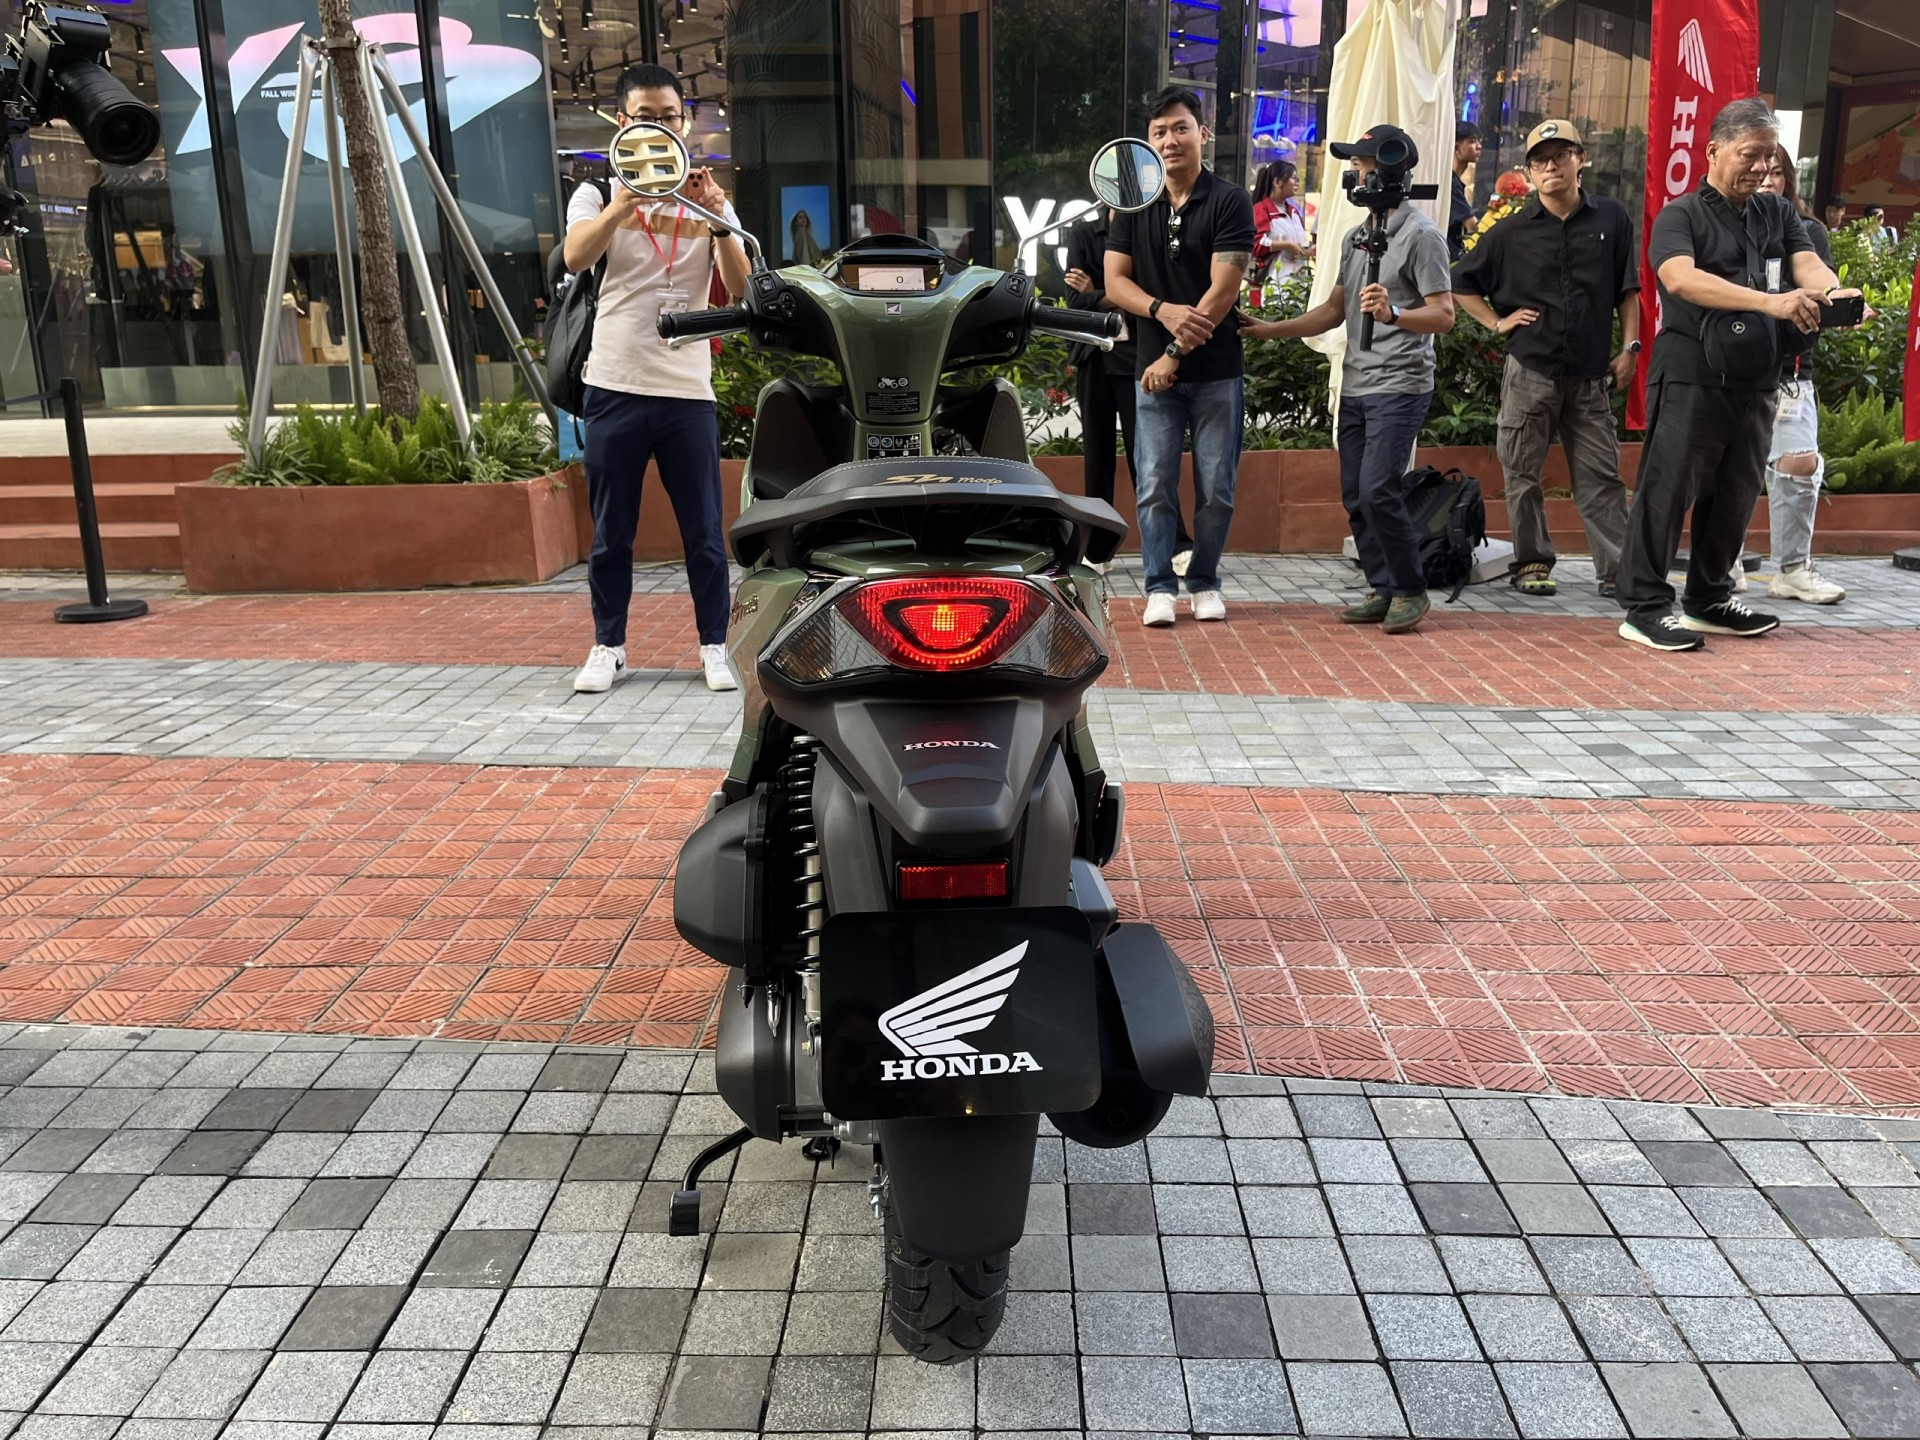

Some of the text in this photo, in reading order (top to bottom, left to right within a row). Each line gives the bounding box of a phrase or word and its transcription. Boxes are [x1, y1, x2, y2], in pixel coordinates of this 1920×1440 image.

[260, 90, 280, 99] FALL
[903, 740, 1001, 751] HONDA
[880, 1051, 1044, 1081] HONDA
